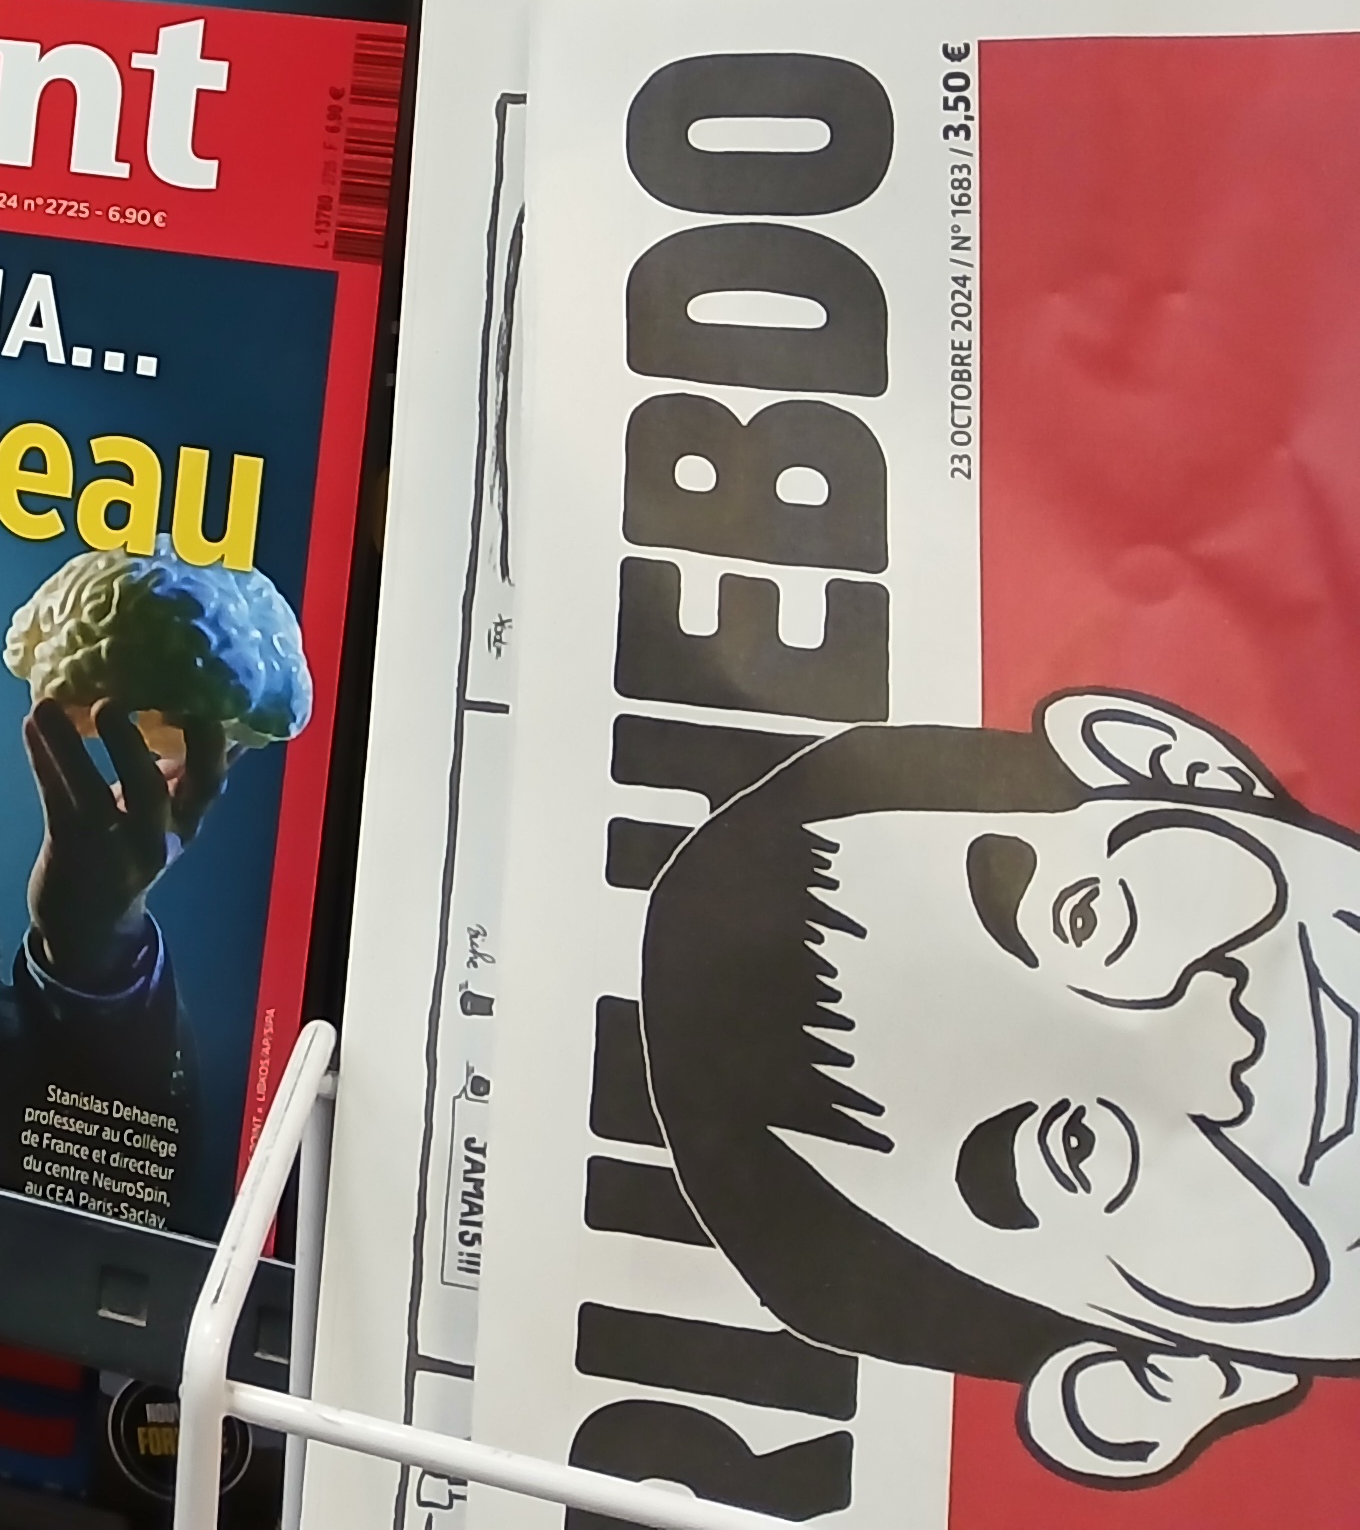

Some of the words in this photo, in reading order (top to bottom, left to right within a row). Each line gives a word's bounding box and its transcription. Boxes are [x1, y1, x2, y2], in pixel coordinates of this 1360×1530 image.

[943, 73, 972, 141] 3,50
[952, 274, 972, 331] 2024
[952, 337, 972, 446] OCTOBRE
[25, 1106, 99, 1139] professeur
[110, 1147, 175, 1180] directeur
